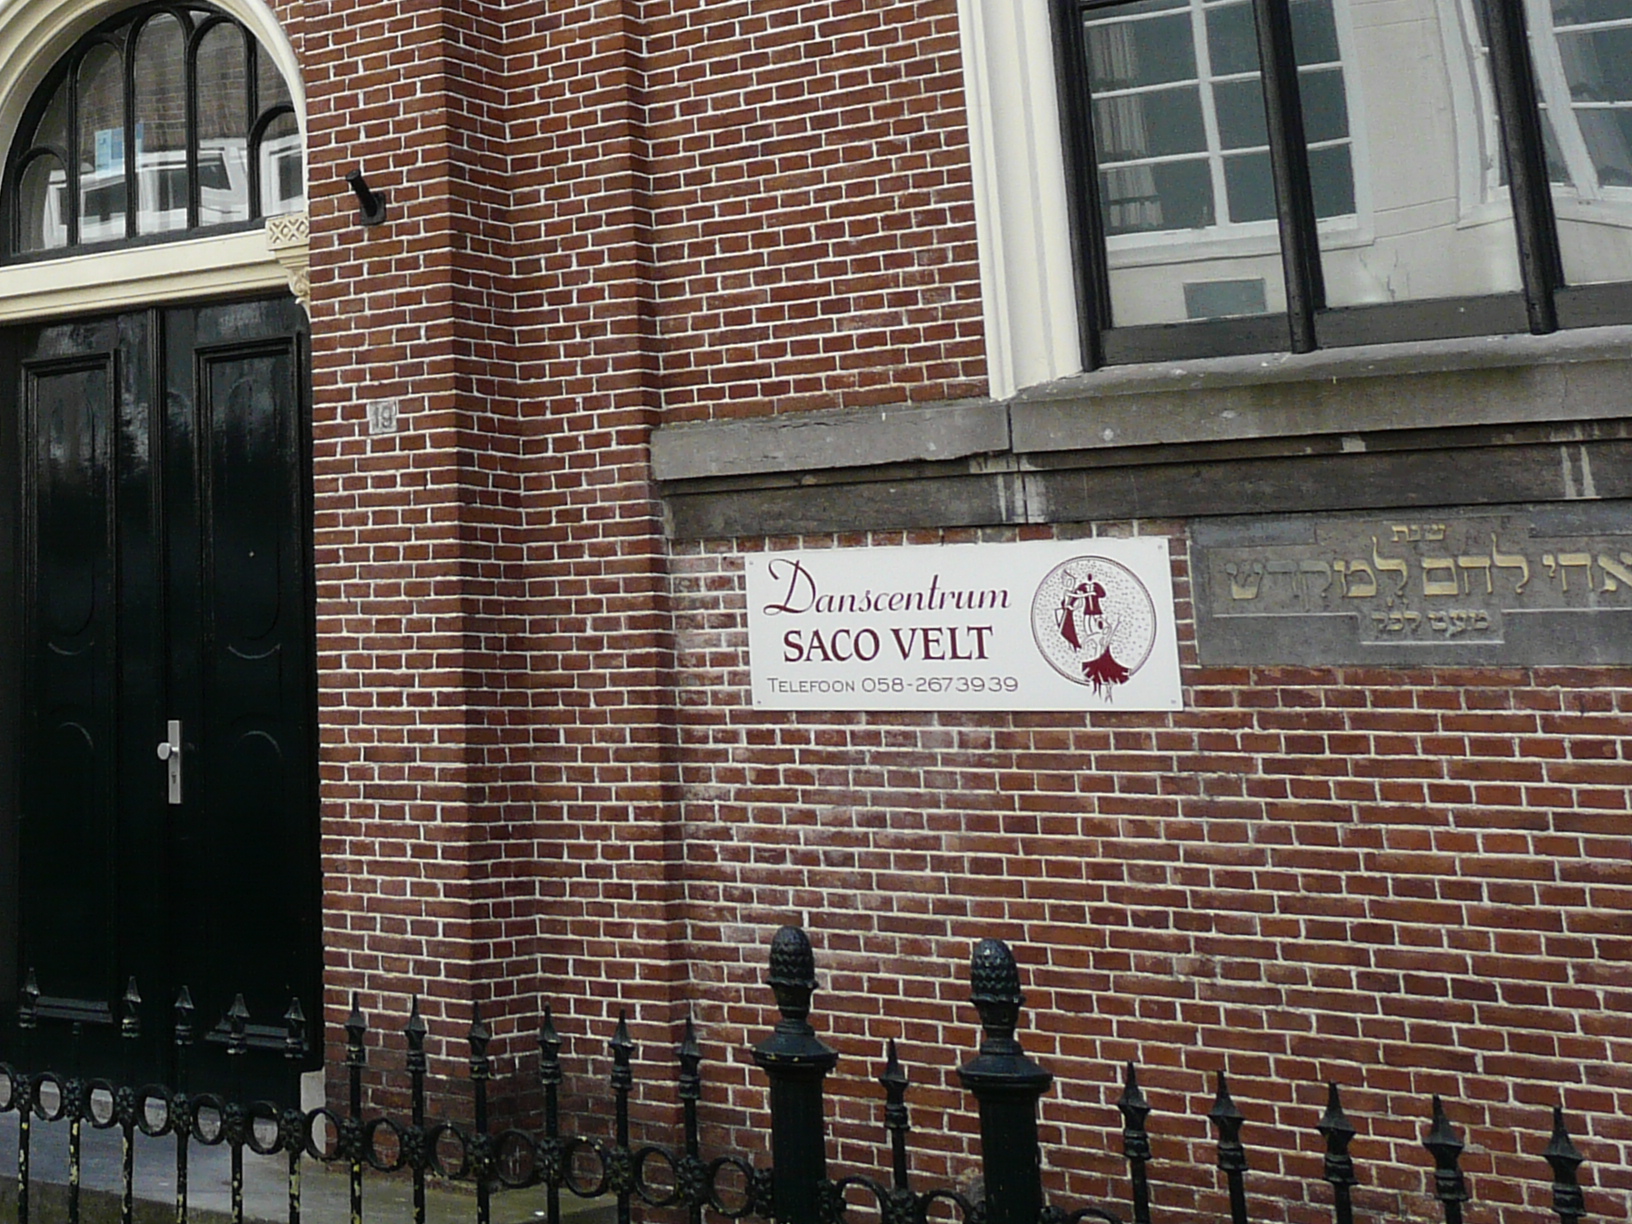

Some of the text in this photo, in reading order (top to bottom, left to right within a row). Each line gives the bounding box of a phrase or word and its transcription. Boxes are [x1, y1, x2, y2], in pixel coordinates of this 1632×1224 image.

[372, 404, 393, 430] 19
[1390, 523, 1446, 542] שנת
[1421, 532, 1529, 596] להם
[763, 558, 1012, 615] Danscentrum
[783, 625, 993, 662] SACO VELT
[766, 676, 1018, 693] TELEFOON 058-2673939
